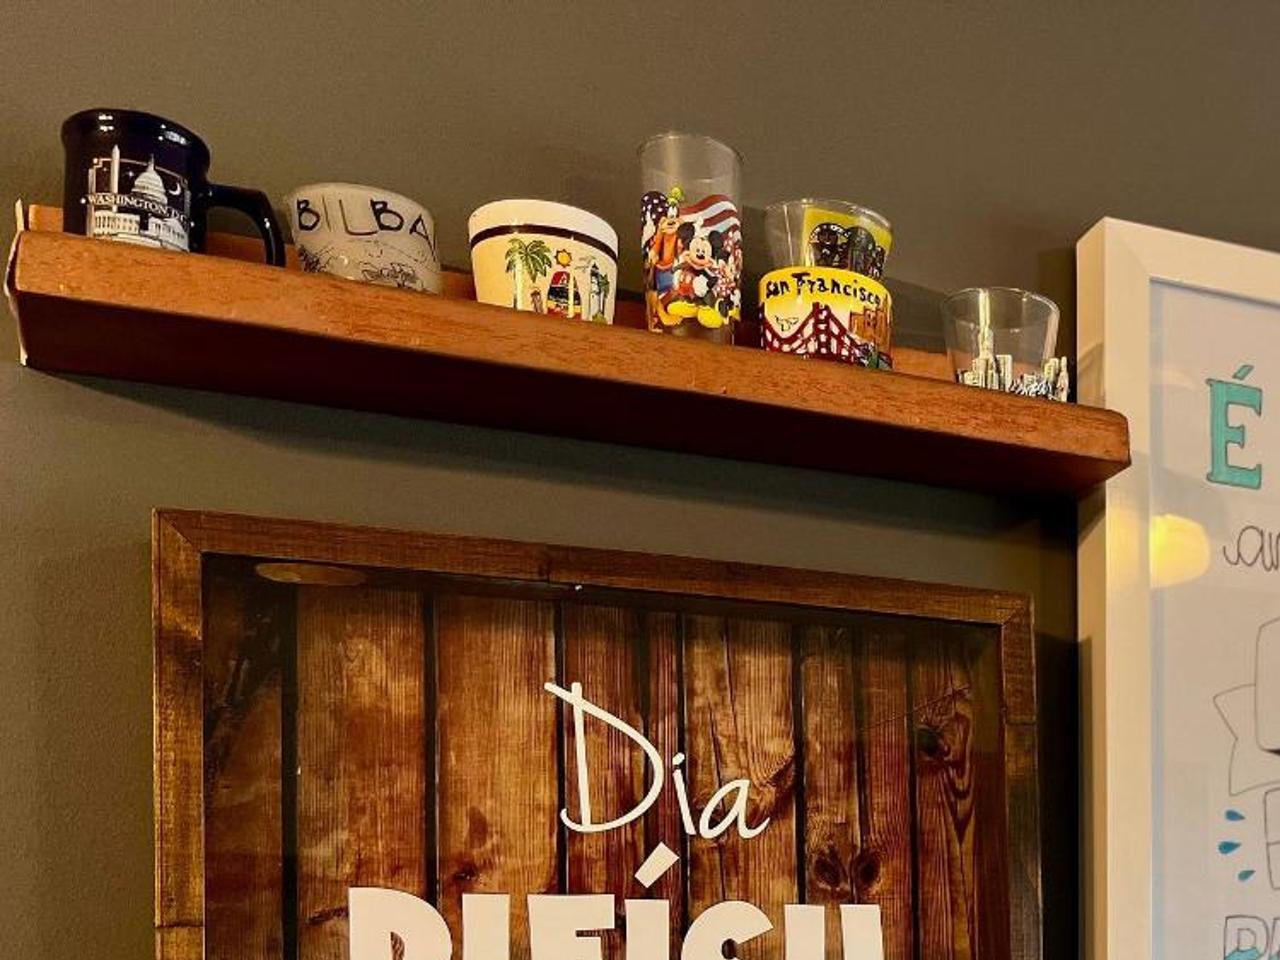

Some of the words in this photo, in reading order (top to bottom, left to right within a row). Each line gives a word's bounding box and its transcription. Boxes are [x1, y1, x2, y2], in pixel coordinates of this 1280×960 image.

[296, 195, 436, 263] BILBA
[1206, 365, 1264, 490] É
[544, 681, 771, 840] Dia
